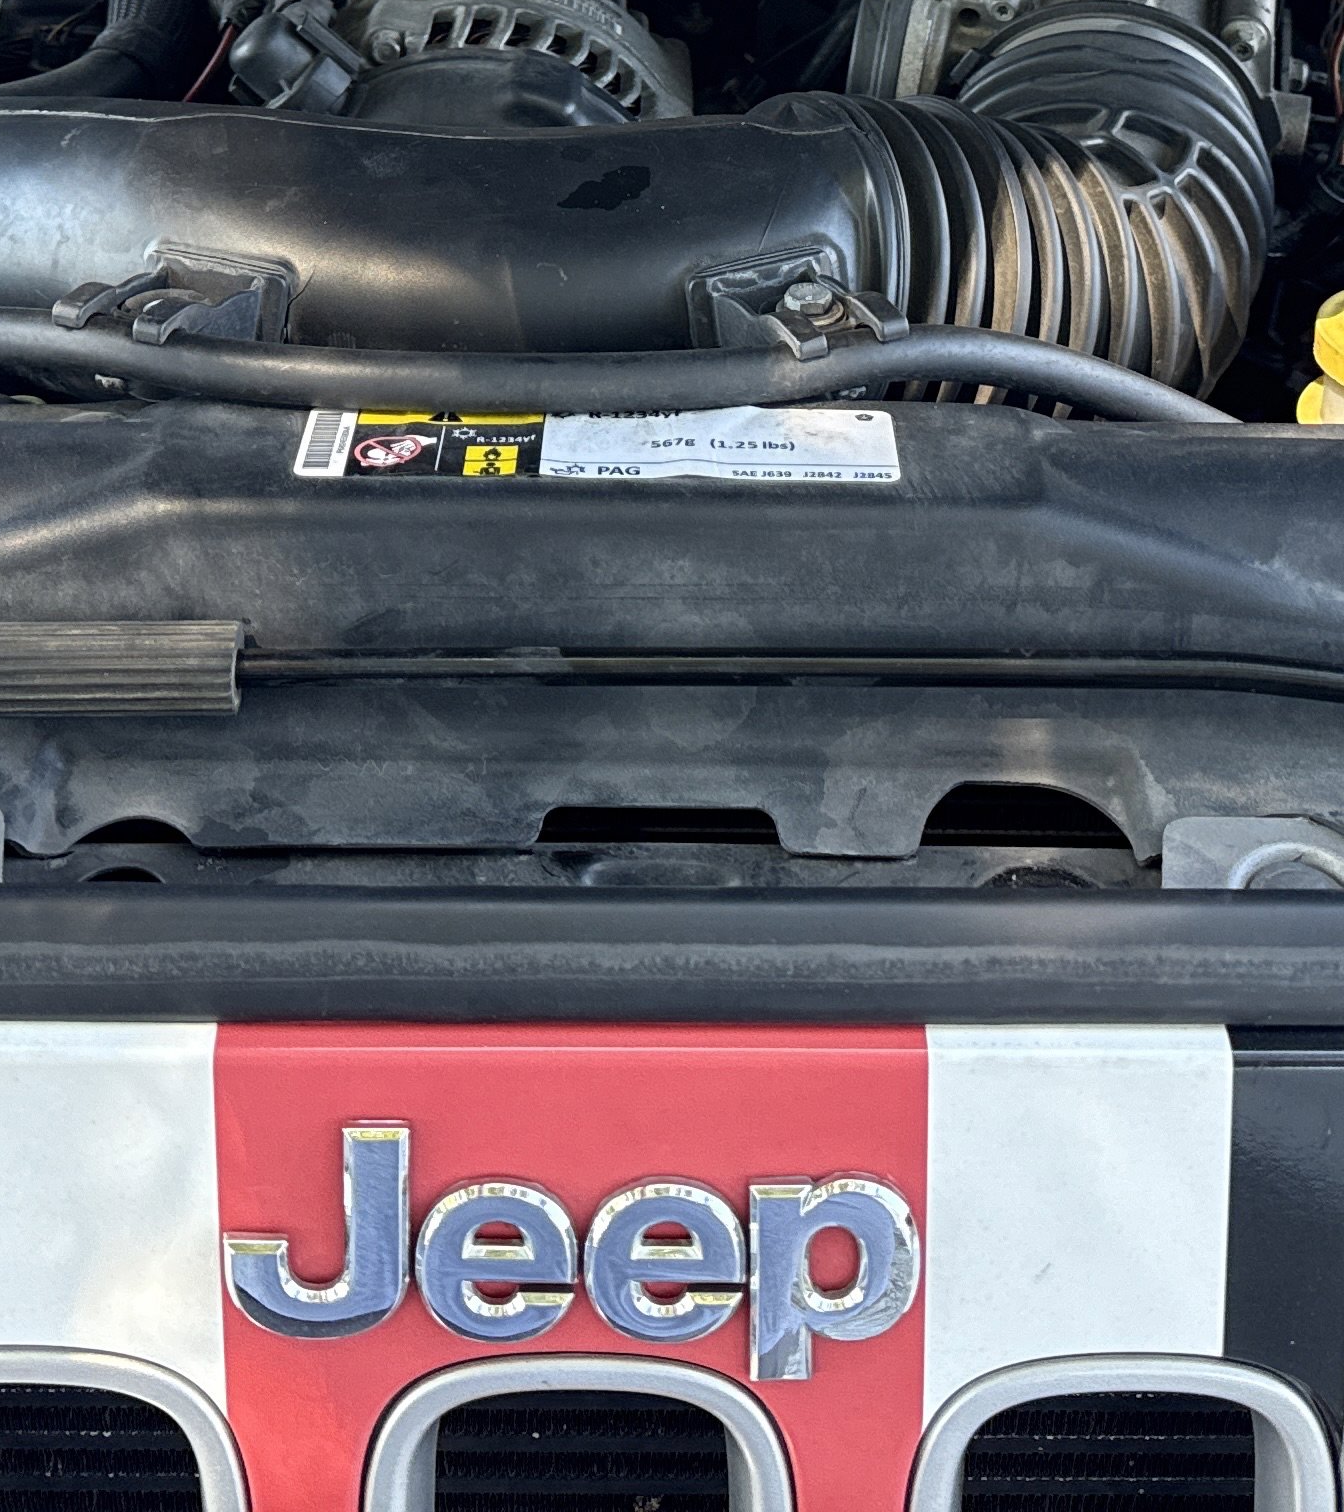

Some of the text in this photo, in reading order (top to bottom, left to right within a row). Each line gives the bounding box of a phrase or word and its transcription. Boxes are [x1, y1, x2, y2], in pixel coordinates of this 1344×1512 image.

[709, 438, 759, 451] (1.25
[762, 440, 796, 452] lbs)
[597, 465, 641, 476] PAG
[223, 1119, 920, 1382] Jeep
